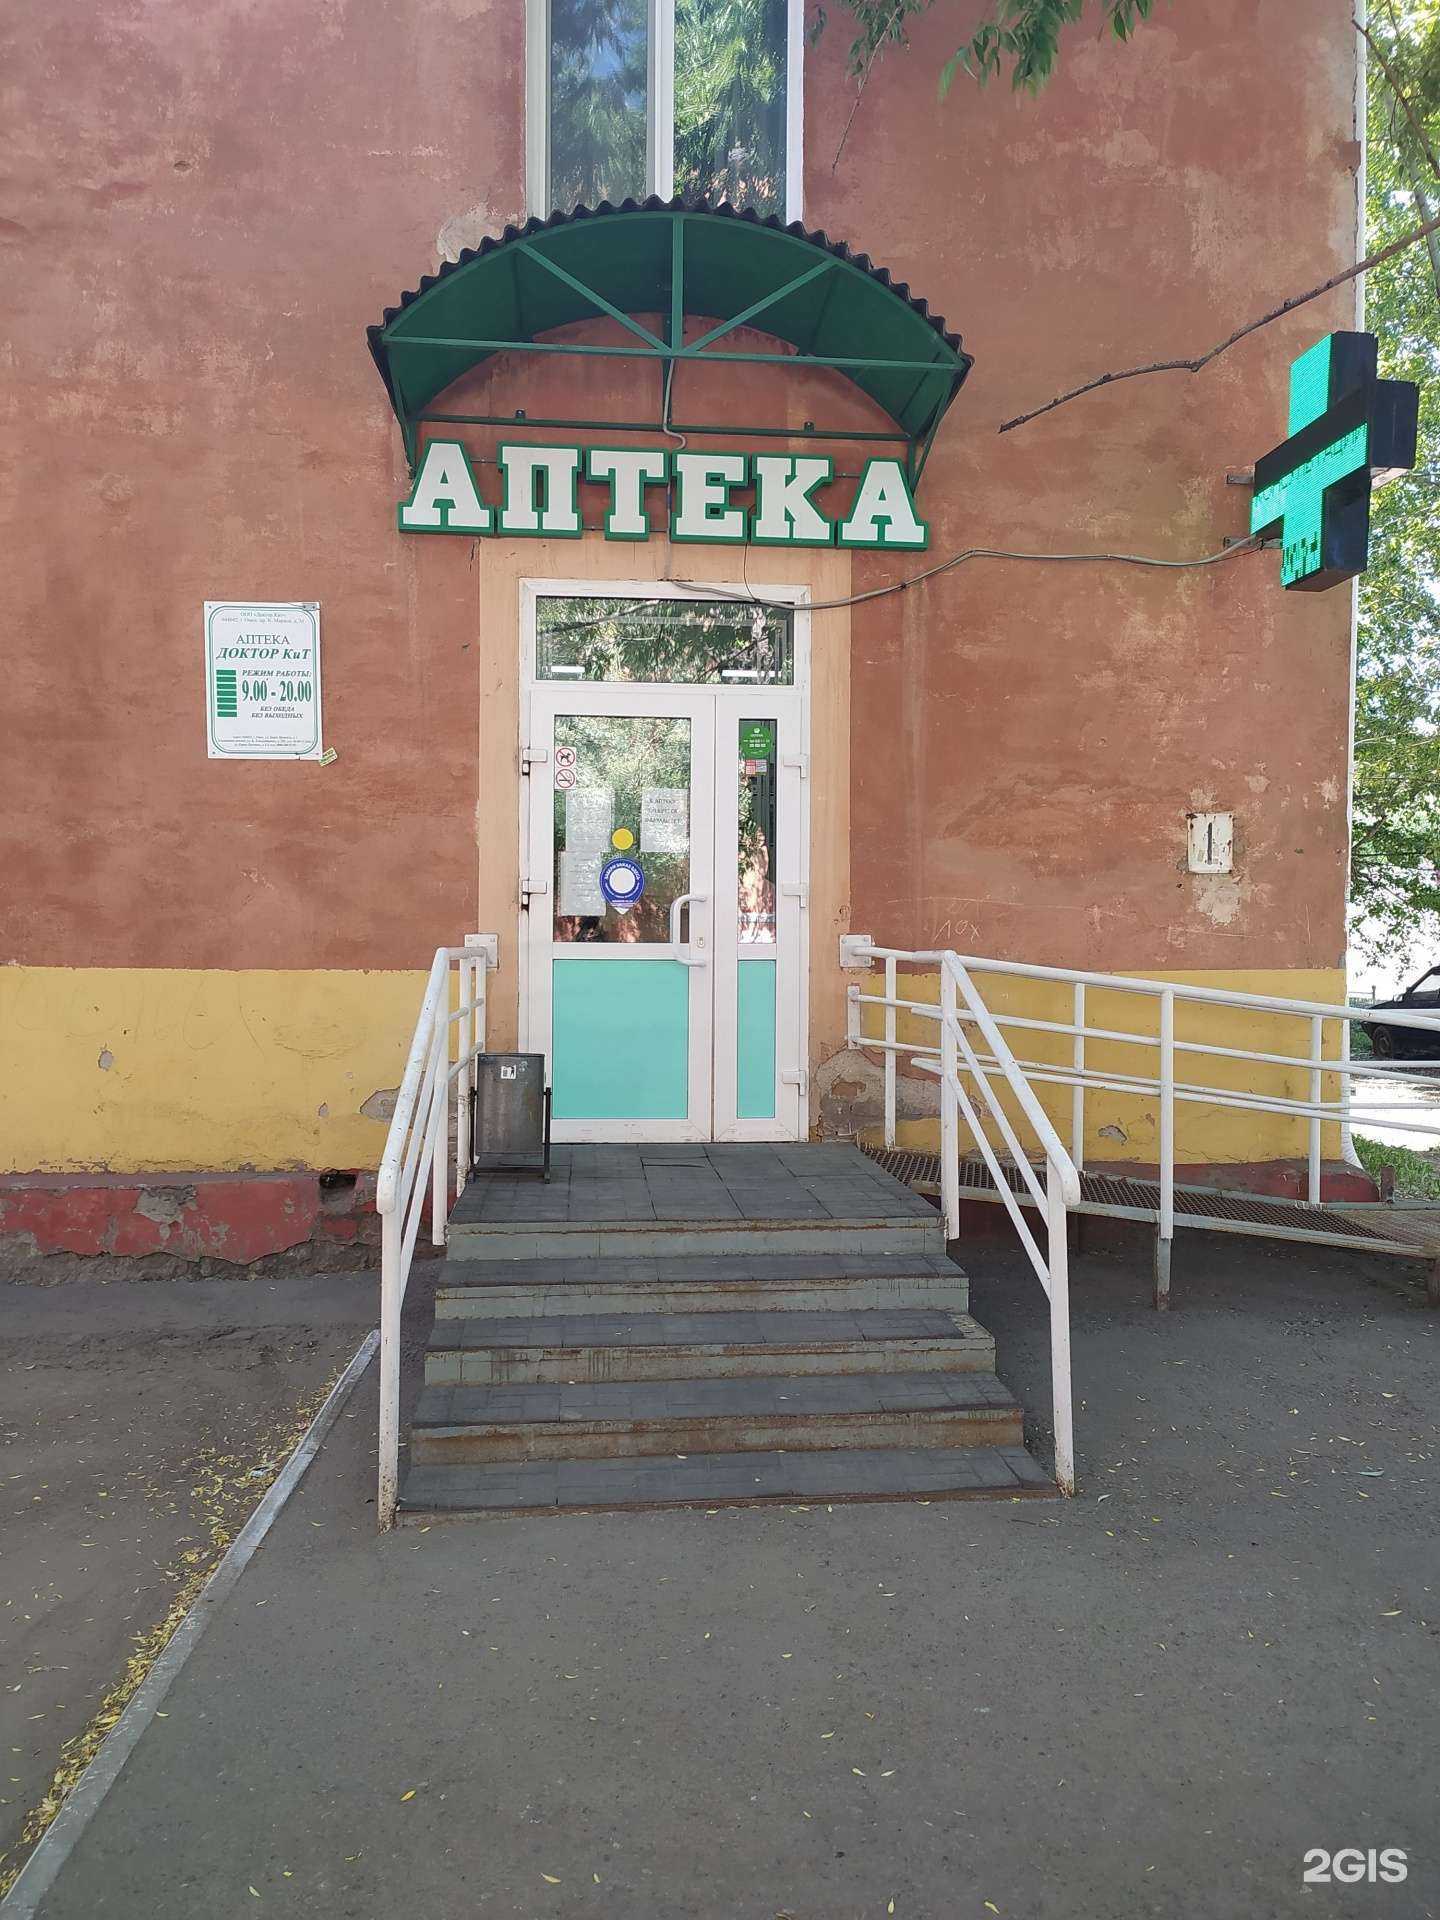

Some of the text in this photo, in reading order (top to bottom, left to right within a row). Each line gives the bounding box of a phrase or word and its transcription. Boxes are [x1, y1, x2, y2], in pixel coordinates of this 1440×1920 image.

[402, 441, 926, 546] АПТЕКА
[236, 634, 290, 645] АПТЕКА
[216, 647, 312, 660] ДОКТОР КиТ
[242, 669, 312, 678] РЕЖИМ РАБОТЫ:
[241, 680, 267, 701] 9.00
[279, 680, 312, 702] 20.00
